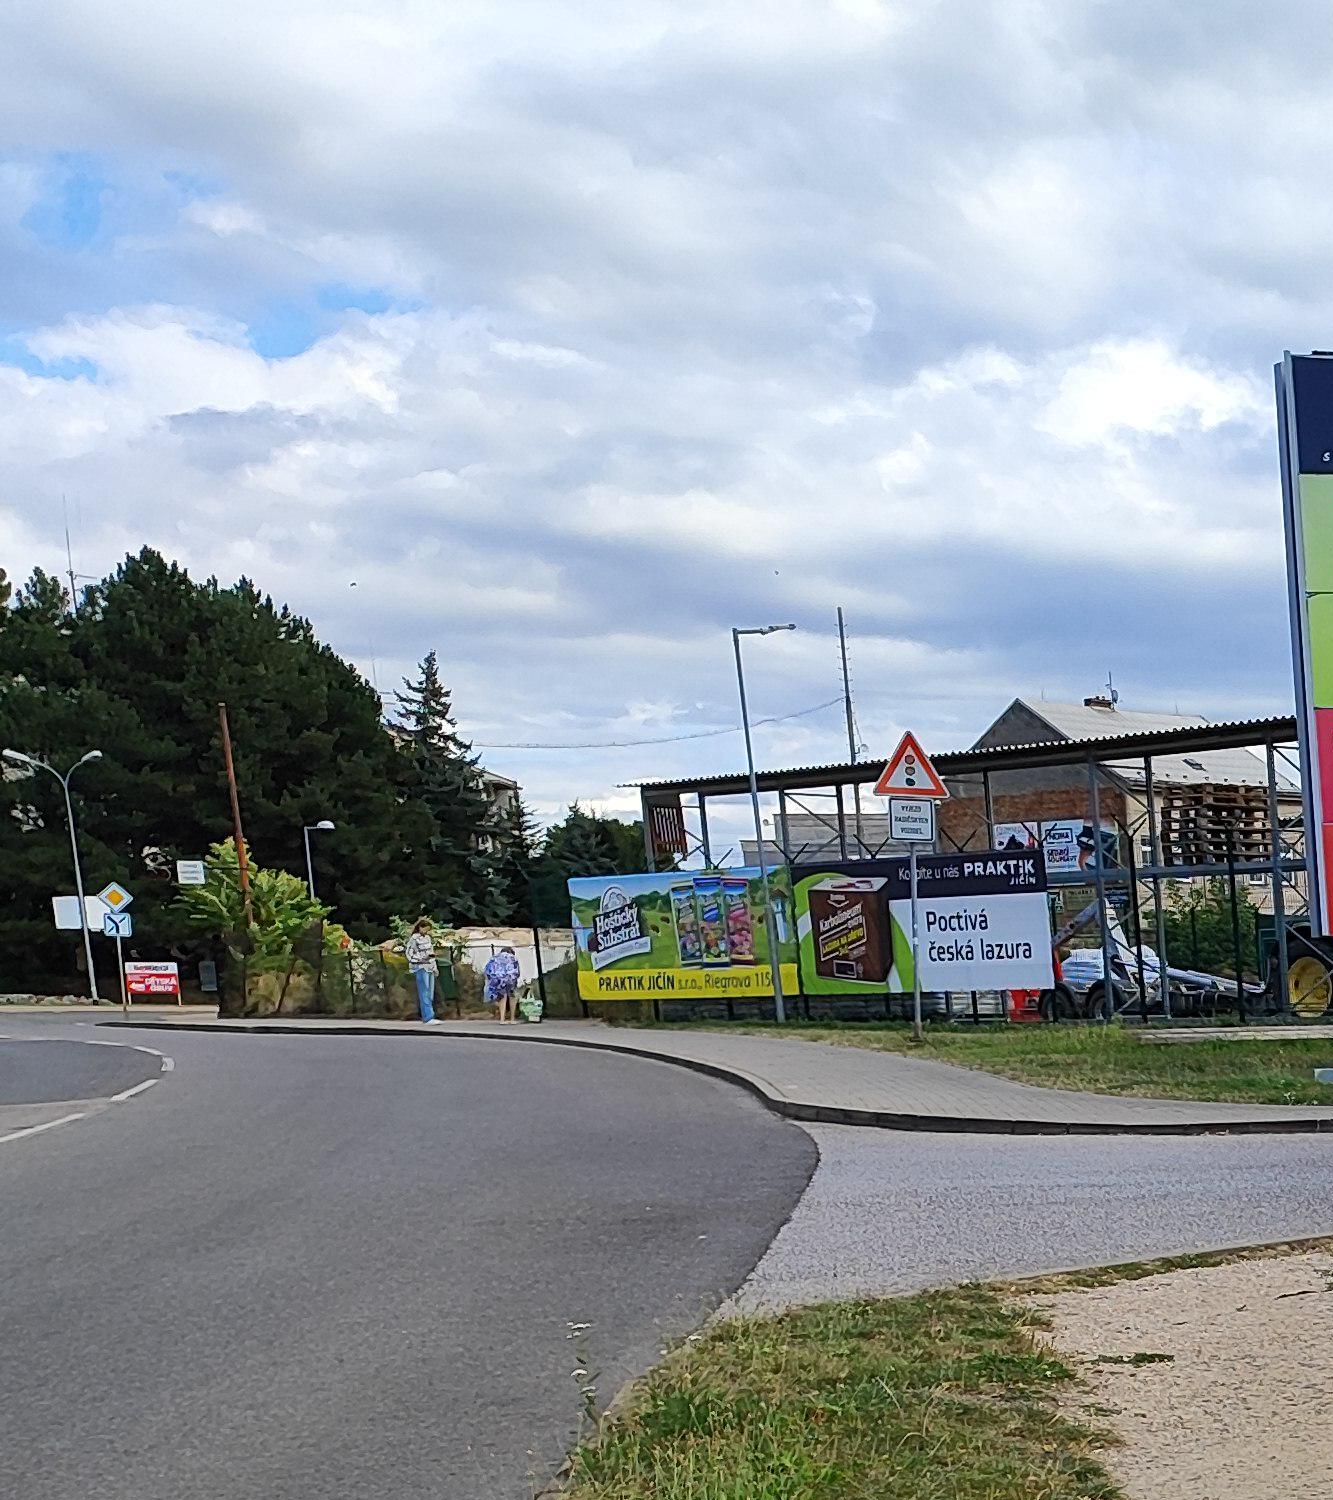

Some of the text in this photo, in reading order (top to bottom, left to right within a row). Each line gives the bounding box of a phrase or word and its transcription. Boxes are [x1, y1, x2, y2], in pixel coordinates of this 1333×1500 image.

[1323, 451, 1330, 462] s
[934, 867, 941, 879] u
[943, 864, 960, 878] nás
[963, 859, 1035, 877] PRAKTIK
[925, 908, 989, 933] Poctivá
[597, 920, 641, 951] Substrát
[928, 938, 1033, 962] česká lazura
[599, 975, 645, 991] PRAKTIK
[647, 971, 675, 991] JIČÍN
[704, 973, 751, 993] Riegrova
[755, 971, 777, 987] 115
